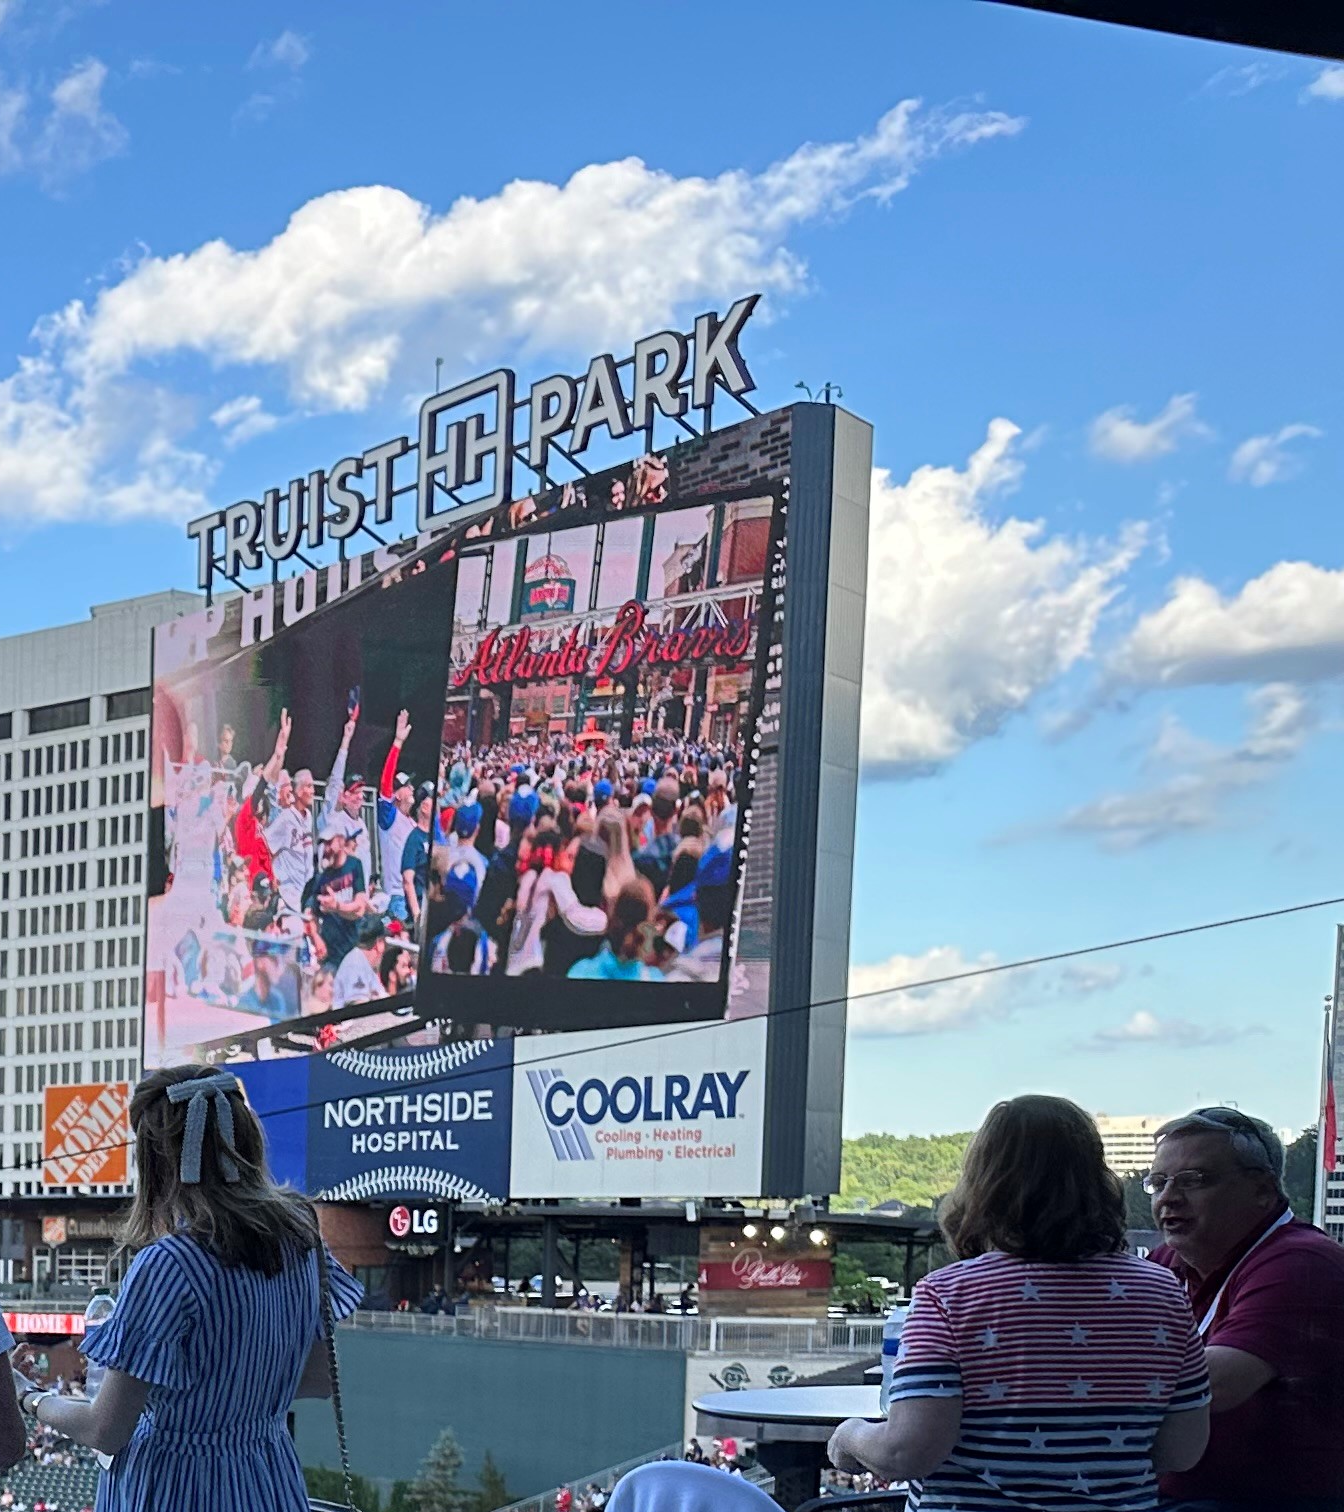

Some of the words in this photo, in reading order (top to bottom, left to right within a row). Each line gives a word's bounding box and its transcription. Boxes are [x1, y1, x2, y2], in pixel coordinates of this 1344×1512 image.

[187, 437, 409, 590] TRUIST
[529, 294, 762, 470] PARK
[452, 622, 589, 687] Atlanta
[595, 599, 752, 677] Braves
[51, 1095, 88, 1135] THE
[324, 1090, 494, 1128] NORTHSIDE
[544, 1070, 751, 1126] COOLRAY
[43, 1083, 130, 1185] HOME
[352, 1130, 460, 1153] HOSPITAL
[595, 1128, 642, 1144] Cooling
[653, 1127, 703, 1142] Heating
[606, 1146, 664, 1162] Plumbing
[675, 1144, 736, 1159] Electrical
[412, 1209, 438, 1234] LG
[19, 1314, 64, 1333] HOME
